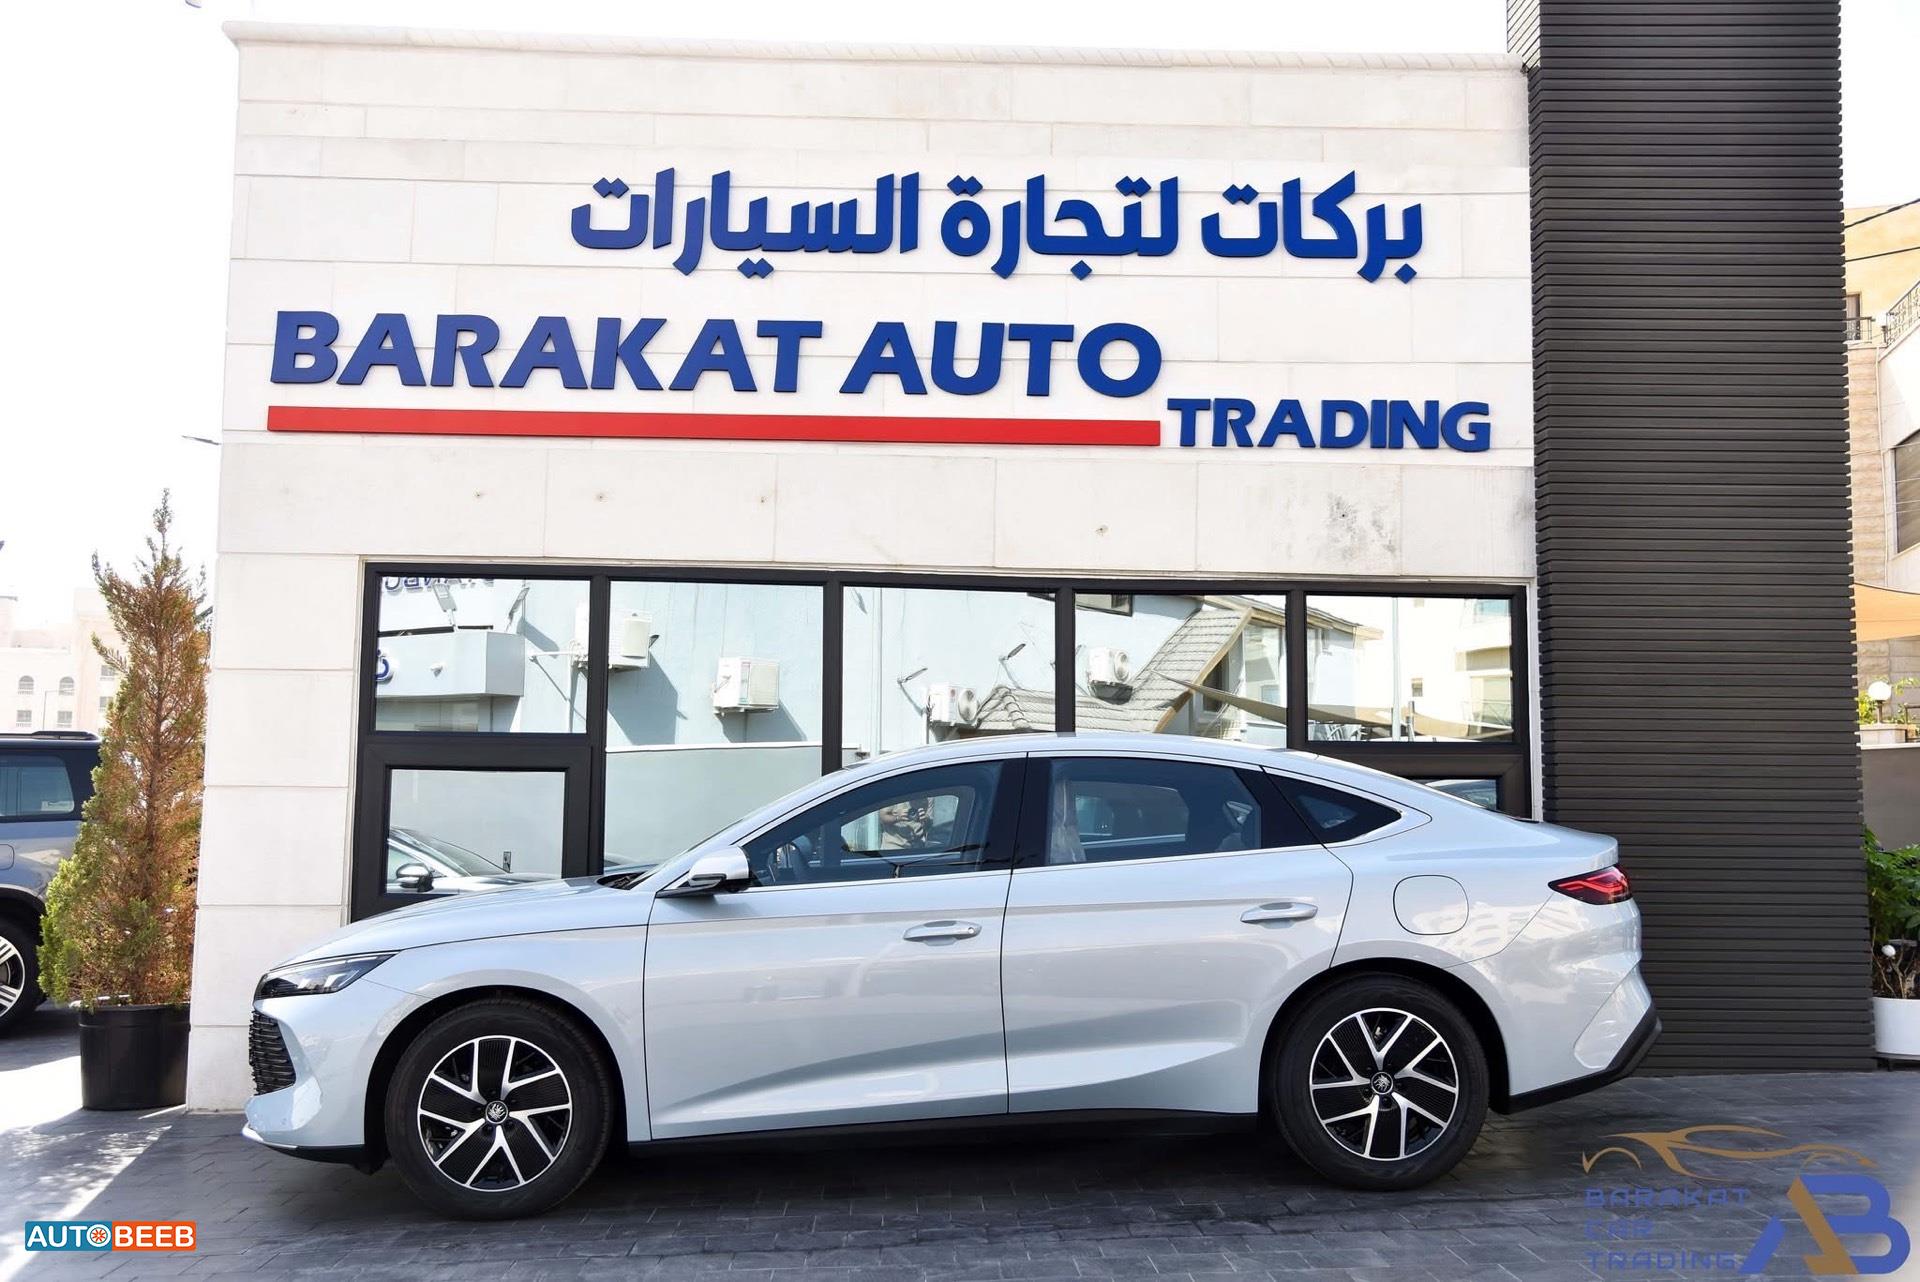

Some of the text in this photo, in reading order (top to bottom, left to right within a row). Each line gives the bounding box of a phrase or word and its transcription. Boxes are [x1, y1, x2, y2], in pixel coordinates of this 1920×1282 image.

[571, 167, 1423, 284] بركات لتجارة السيارات
[270, 311, 1162, 398] BARAKAT AUTO
[1167, 397, 1492, 452] TRADING
